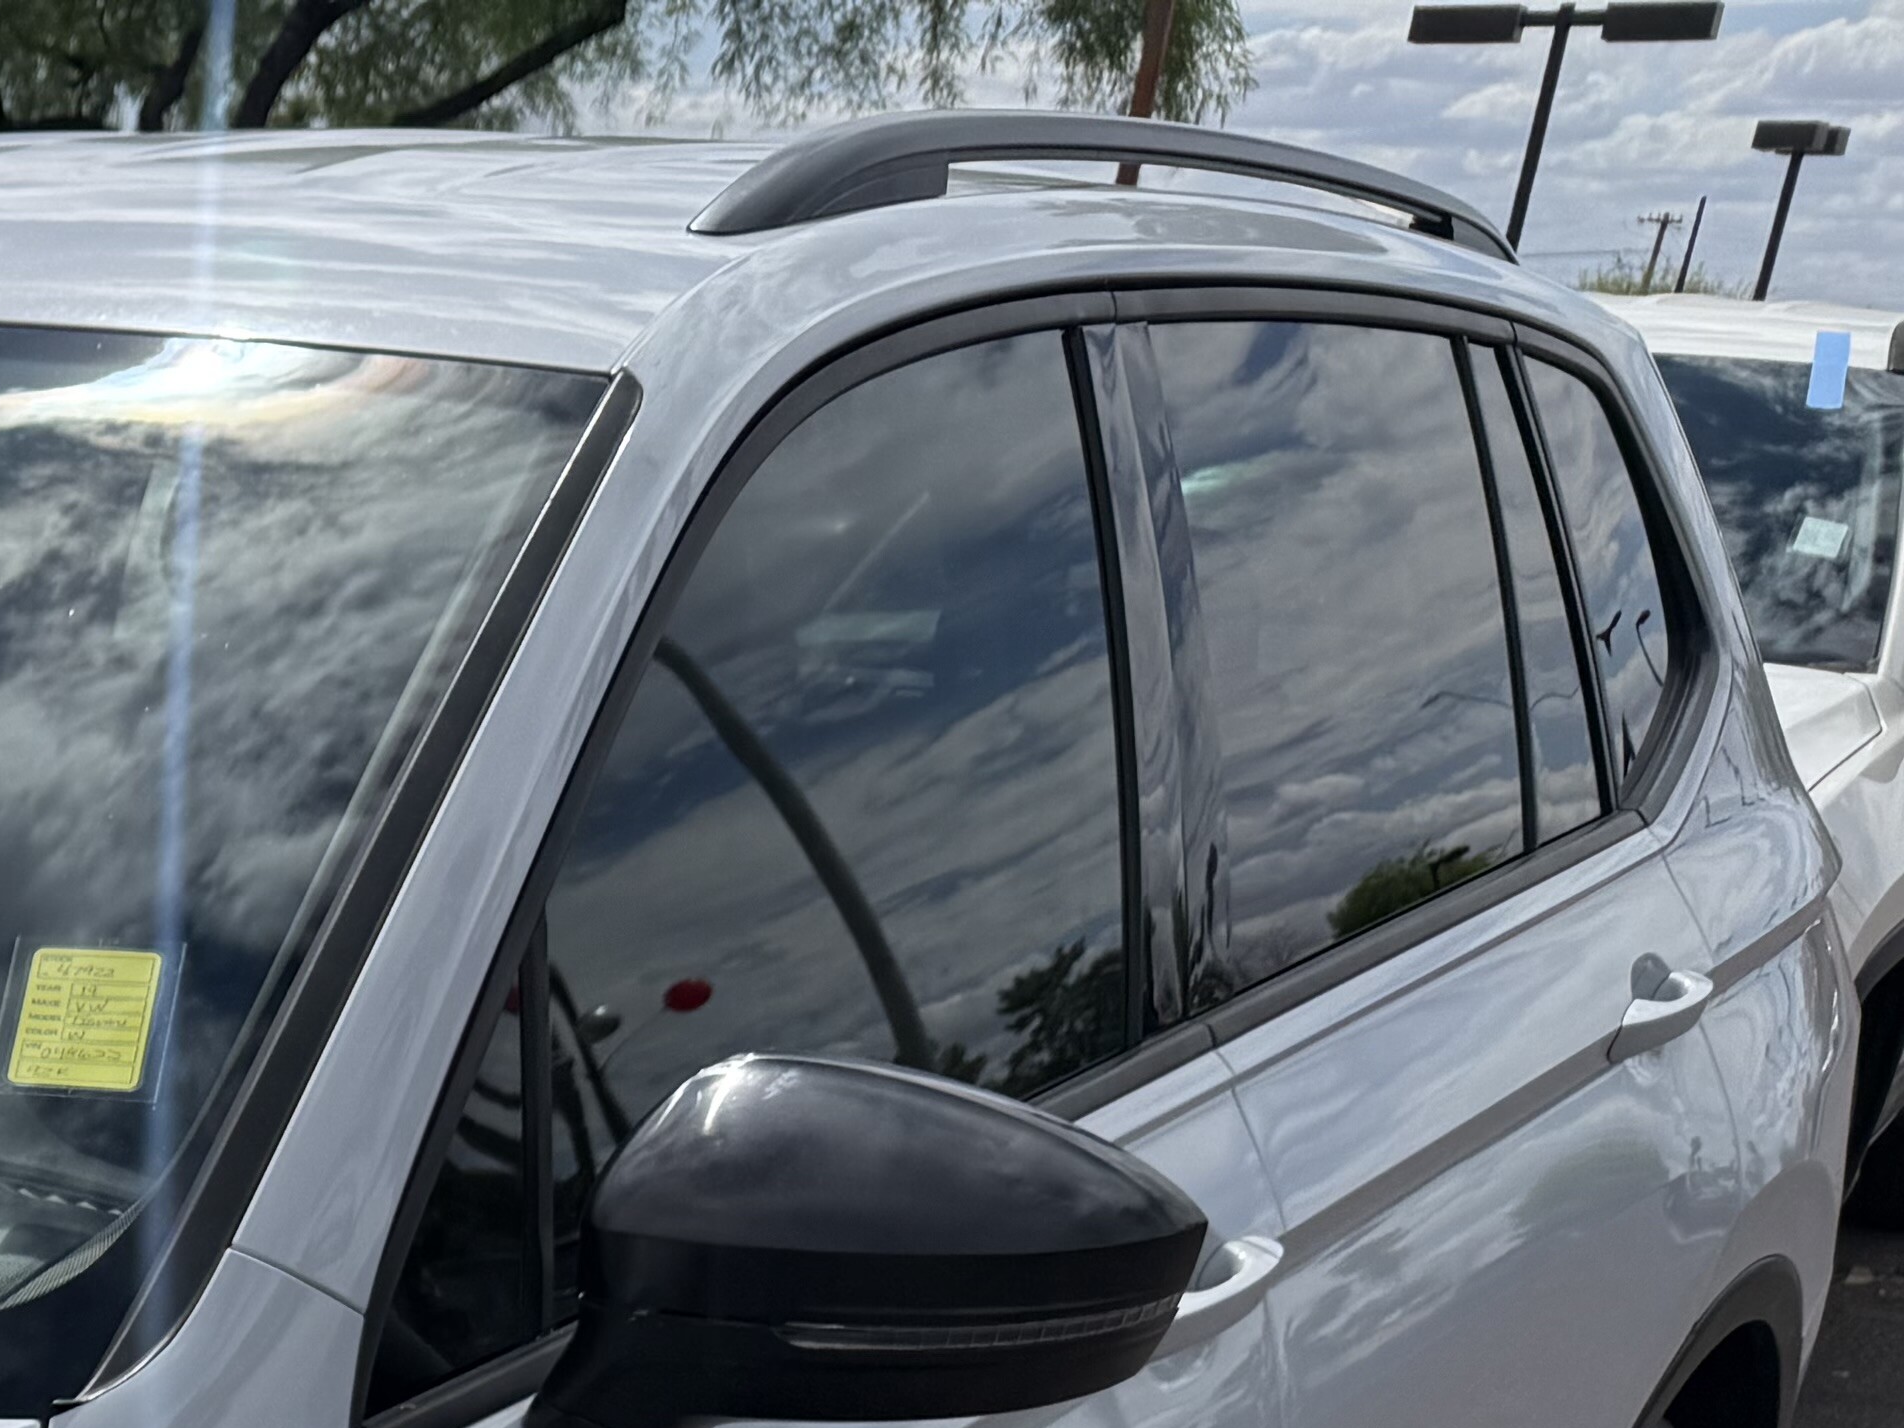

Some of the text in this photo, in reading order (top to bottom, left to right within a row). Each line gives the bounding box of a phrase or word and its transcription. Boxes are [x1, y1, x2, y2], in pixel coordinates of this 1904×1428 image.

[36, 984, 62, 992] YEAR
[31, 998, 61, 1008] MAKE
[28, 1013, 62, 1022] MODEL
[25, 1027, 59, 1037] COLOR
